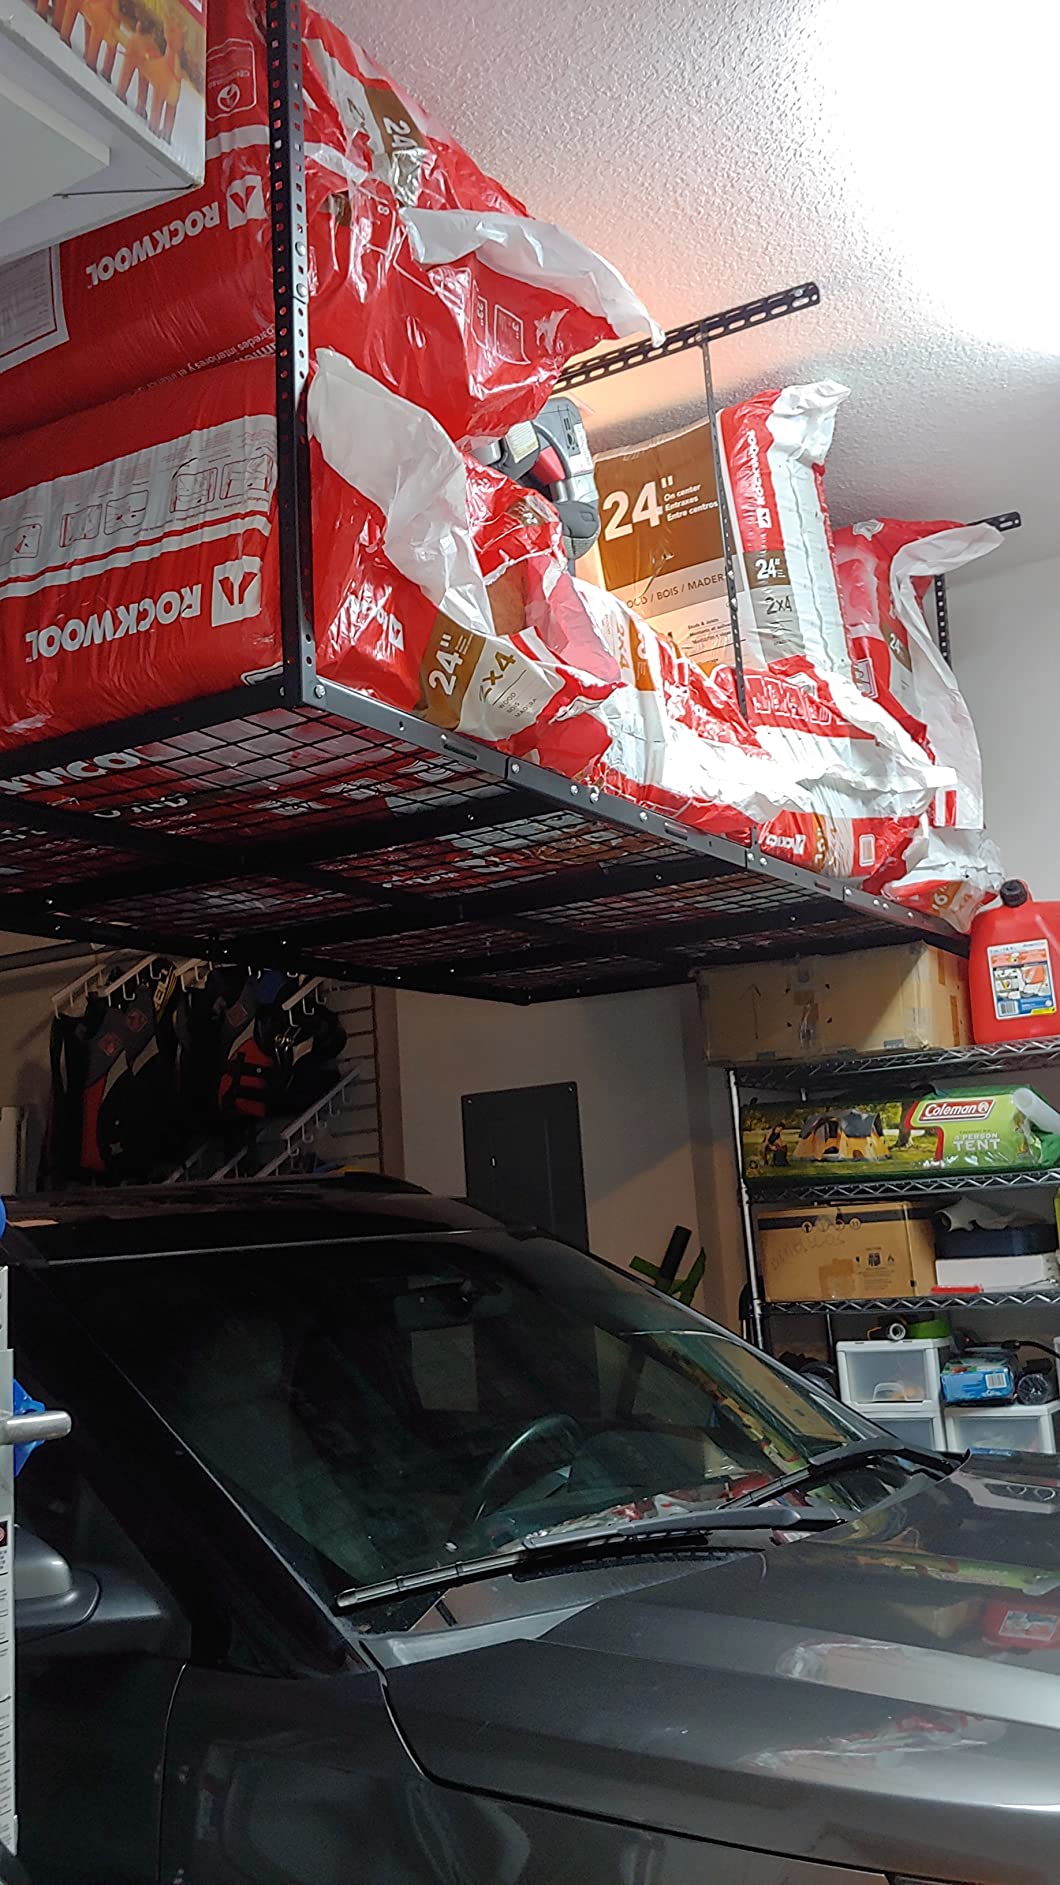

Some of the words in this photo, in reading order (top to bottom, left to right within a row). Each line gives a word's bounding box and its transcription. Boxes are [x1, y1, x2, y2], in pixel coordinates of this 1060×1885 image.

[86, 201, 220, 288] ROCKWOOL
[745, 428, 767, 505] ROCKWOOL
[602, 474, 675, 542] 24"
[656, 586, 680, 601] BOIS
[687, 572, 726, 591] MADER
[25, 583, 202, 662] ROCKWOOL
[428, 633, 464, 697] 24"
[478, 651, 517, 702] 2x4
[925, 1103, 977, 1117] Coleman
[953, 1138, 1001, 1152] TENT
